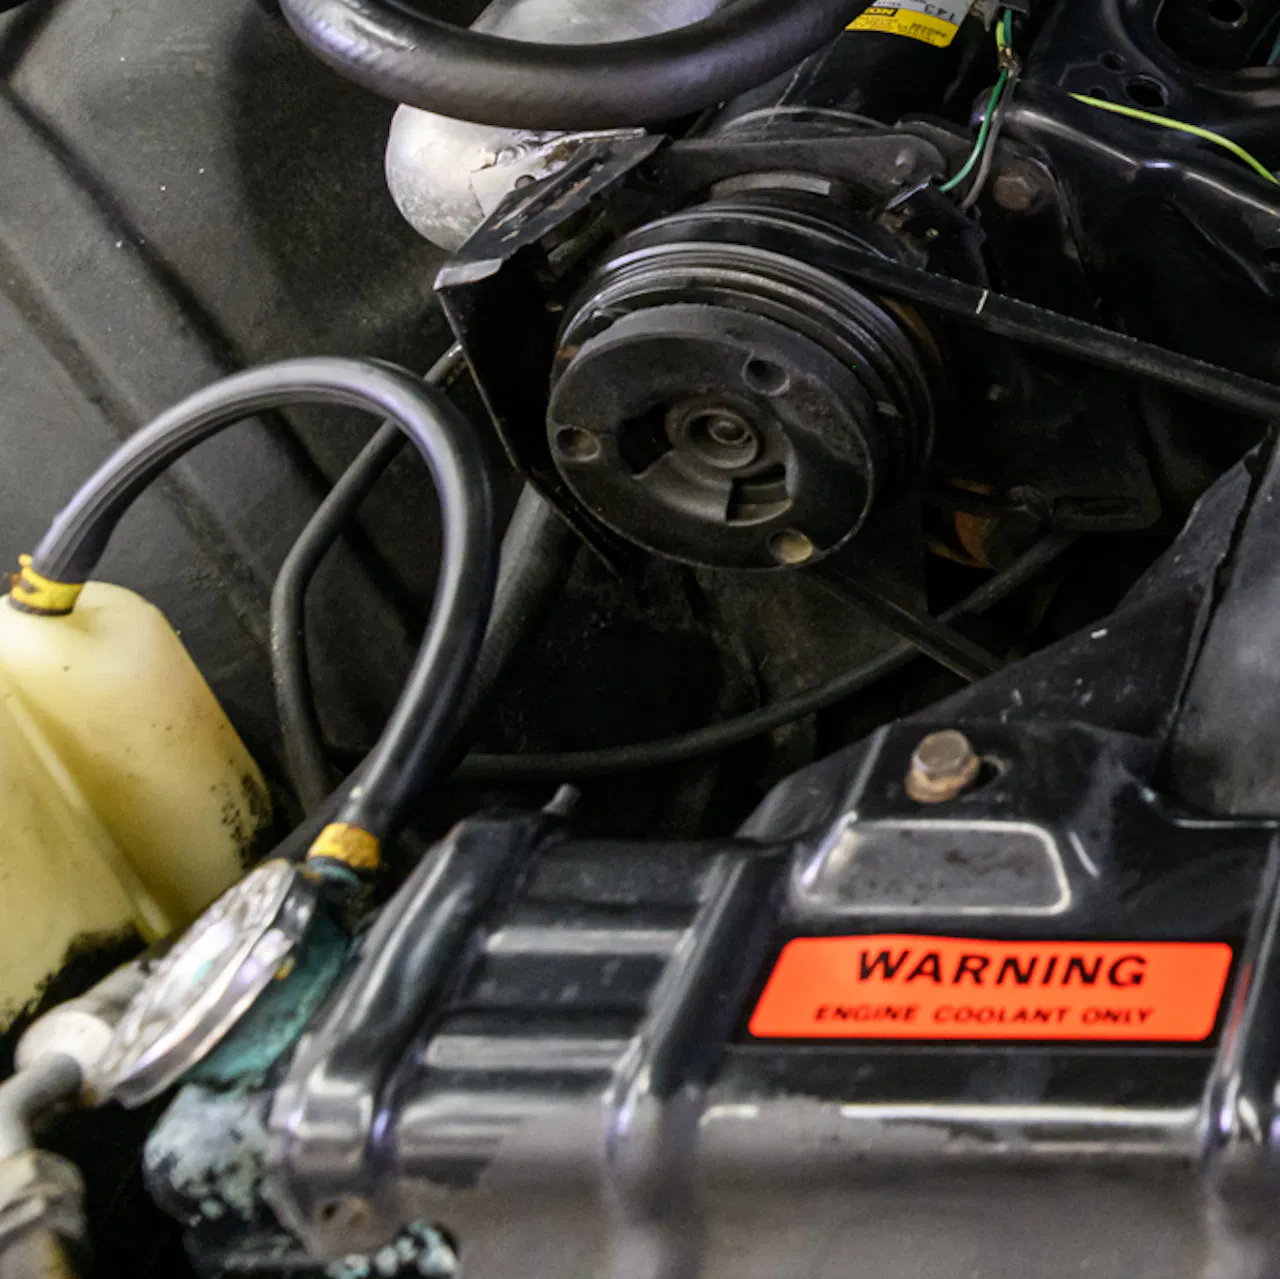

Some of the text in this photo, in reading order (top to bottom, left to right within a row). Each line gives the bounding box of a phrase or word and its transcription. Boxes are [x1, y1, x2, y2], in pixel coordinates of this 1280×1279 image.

[857, 949, 1148, 988] WARNING
[814, 1004, 1154, 1026] ENGINE COOLANT ONLY
